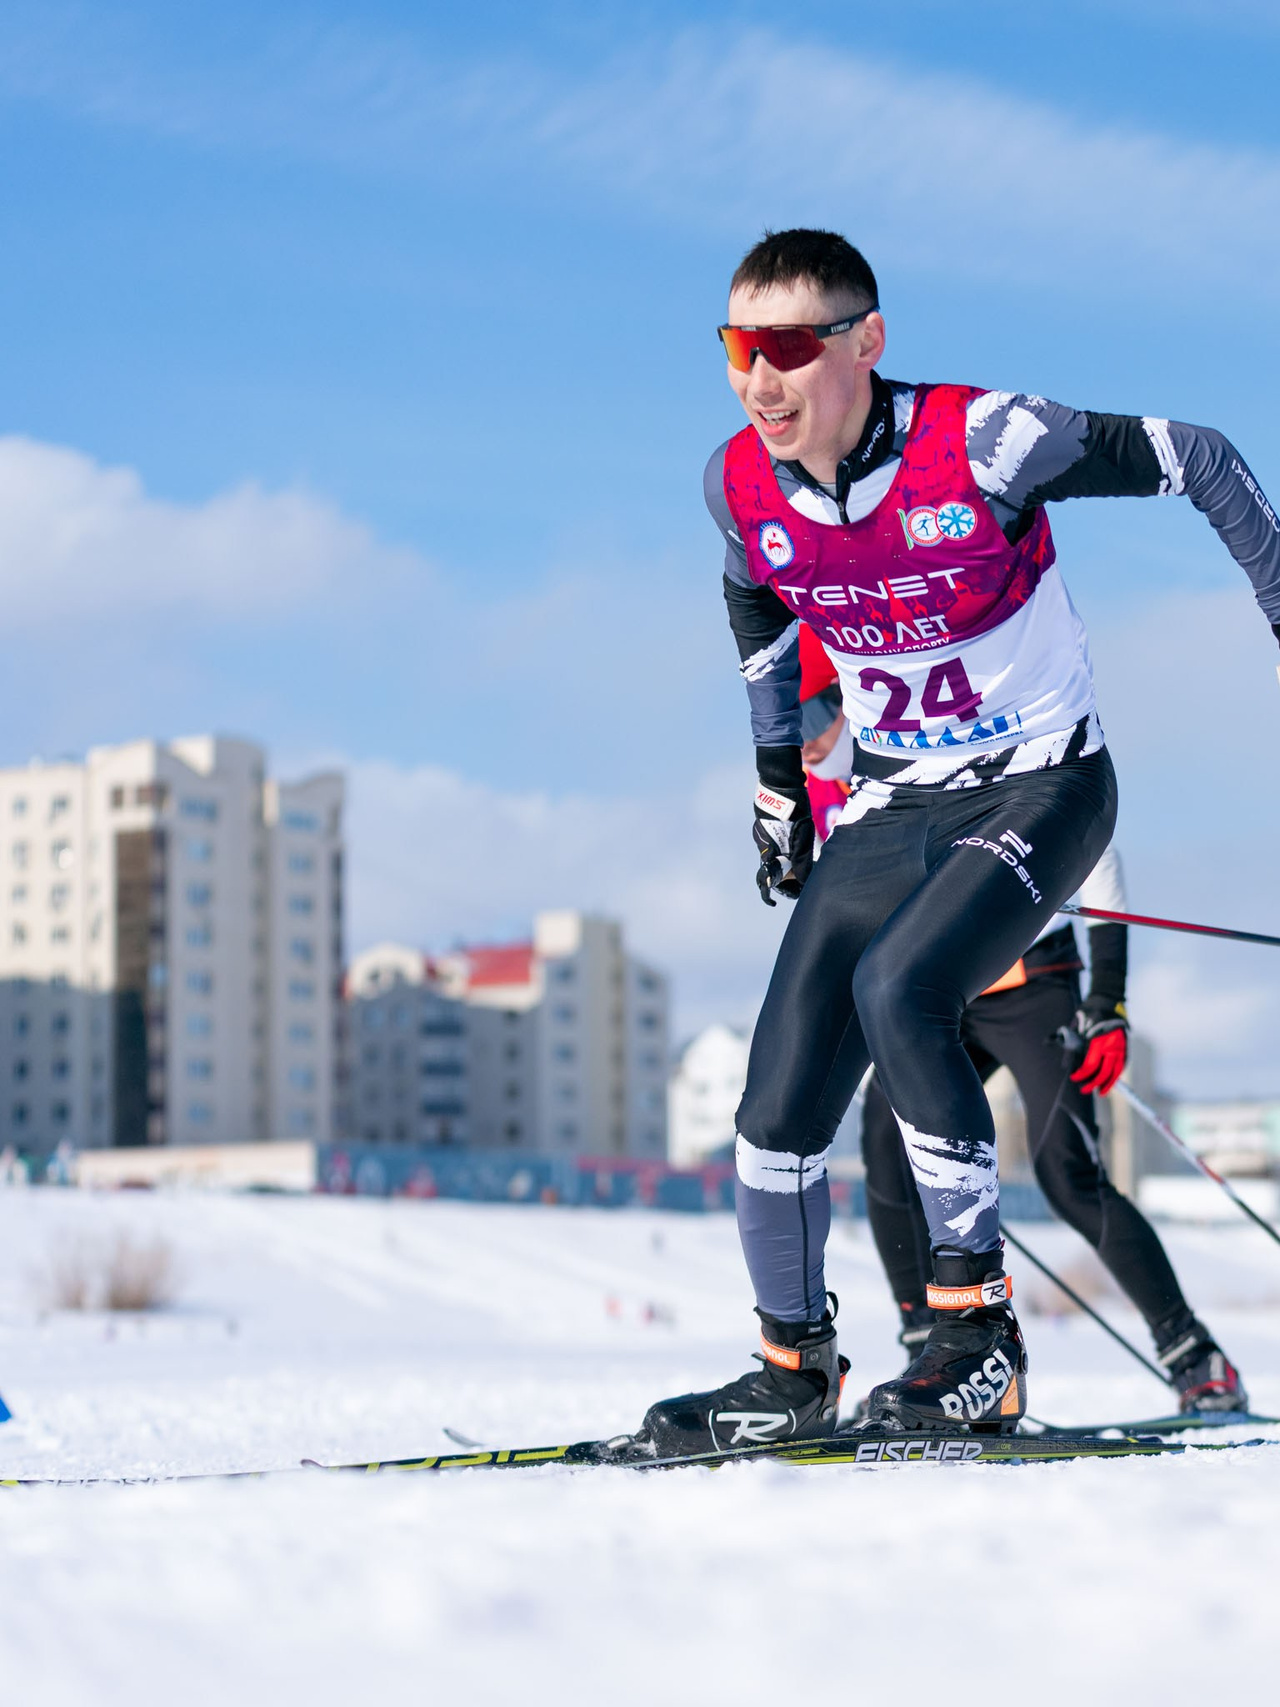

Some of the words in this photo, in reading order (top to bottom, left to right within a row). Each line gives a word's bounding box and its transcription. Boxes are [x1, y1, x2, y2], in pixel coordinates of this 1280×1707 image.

[778, 567, 966, 606] TENET
[826, 624, 885, 649] 100
[896, 614, 951, 644] ЛЕТ
[858, 656, 984, 732] 24
[951, 837, 1042, 904] NORDSKI
[939, 1347, 1014, 1420] ROSSI
